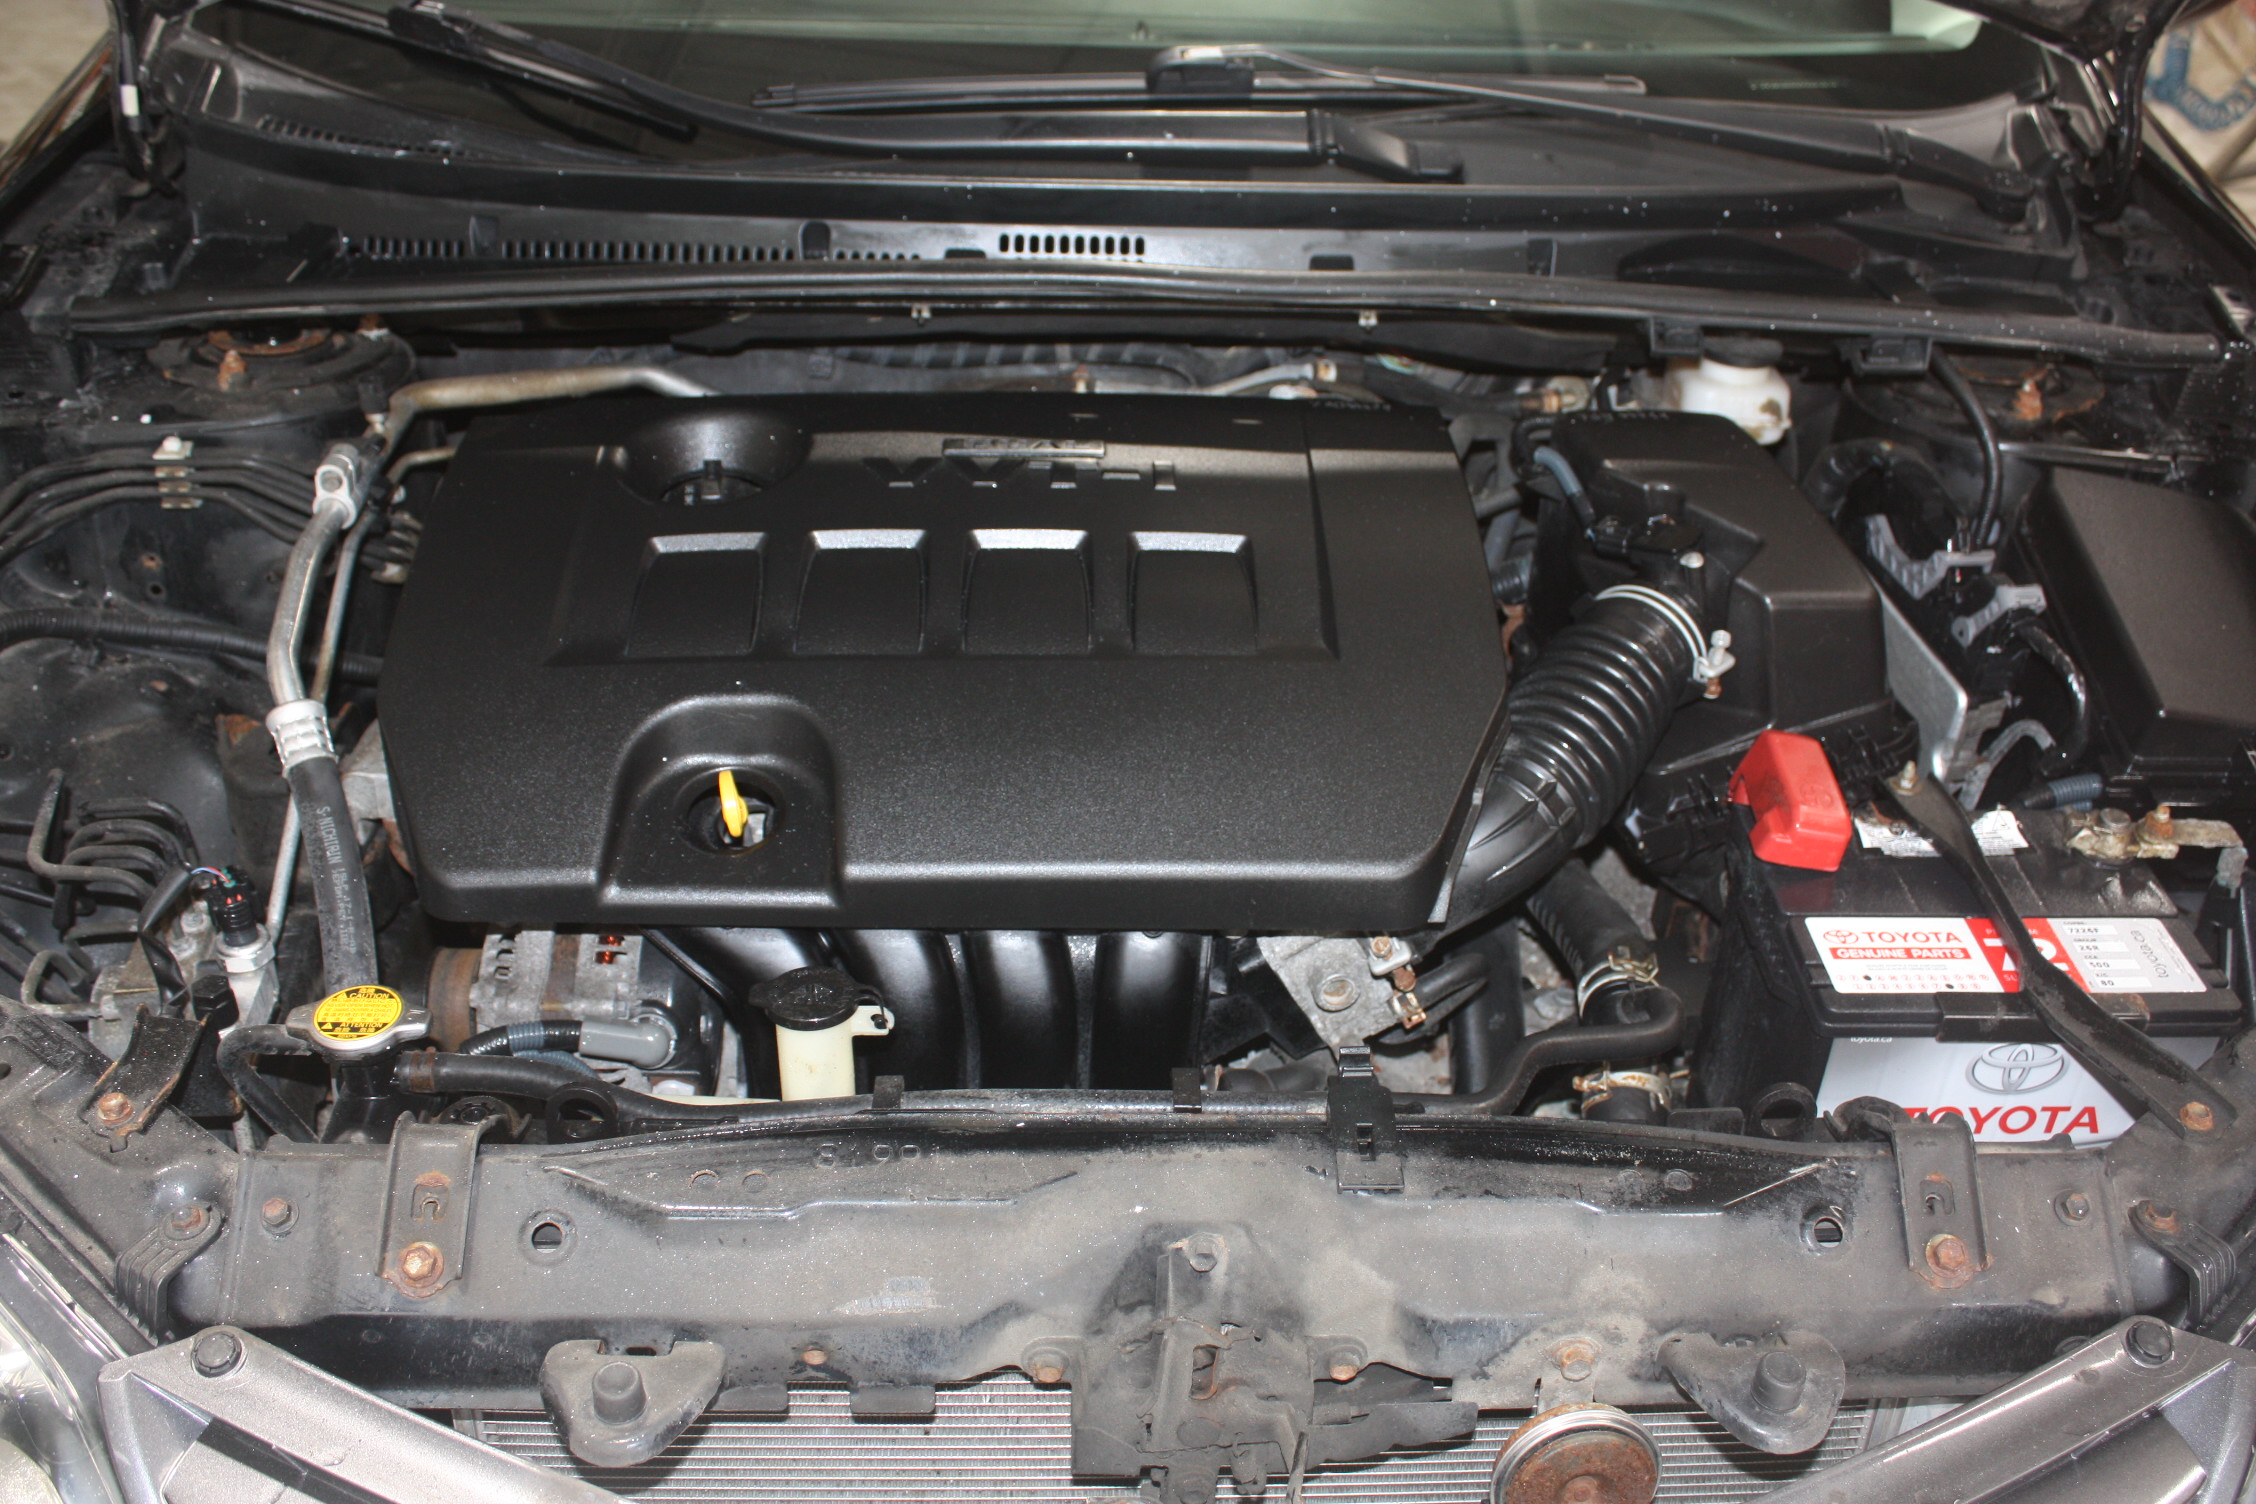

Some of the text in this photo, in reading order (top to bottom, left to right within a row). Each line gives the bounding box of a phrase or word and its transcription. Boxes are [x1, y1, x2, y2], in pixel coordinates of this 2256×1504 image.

[1861, 931, 1963, 944] TOYOTA
[1836, 948, 1965, 959] GENUINE PARTS
